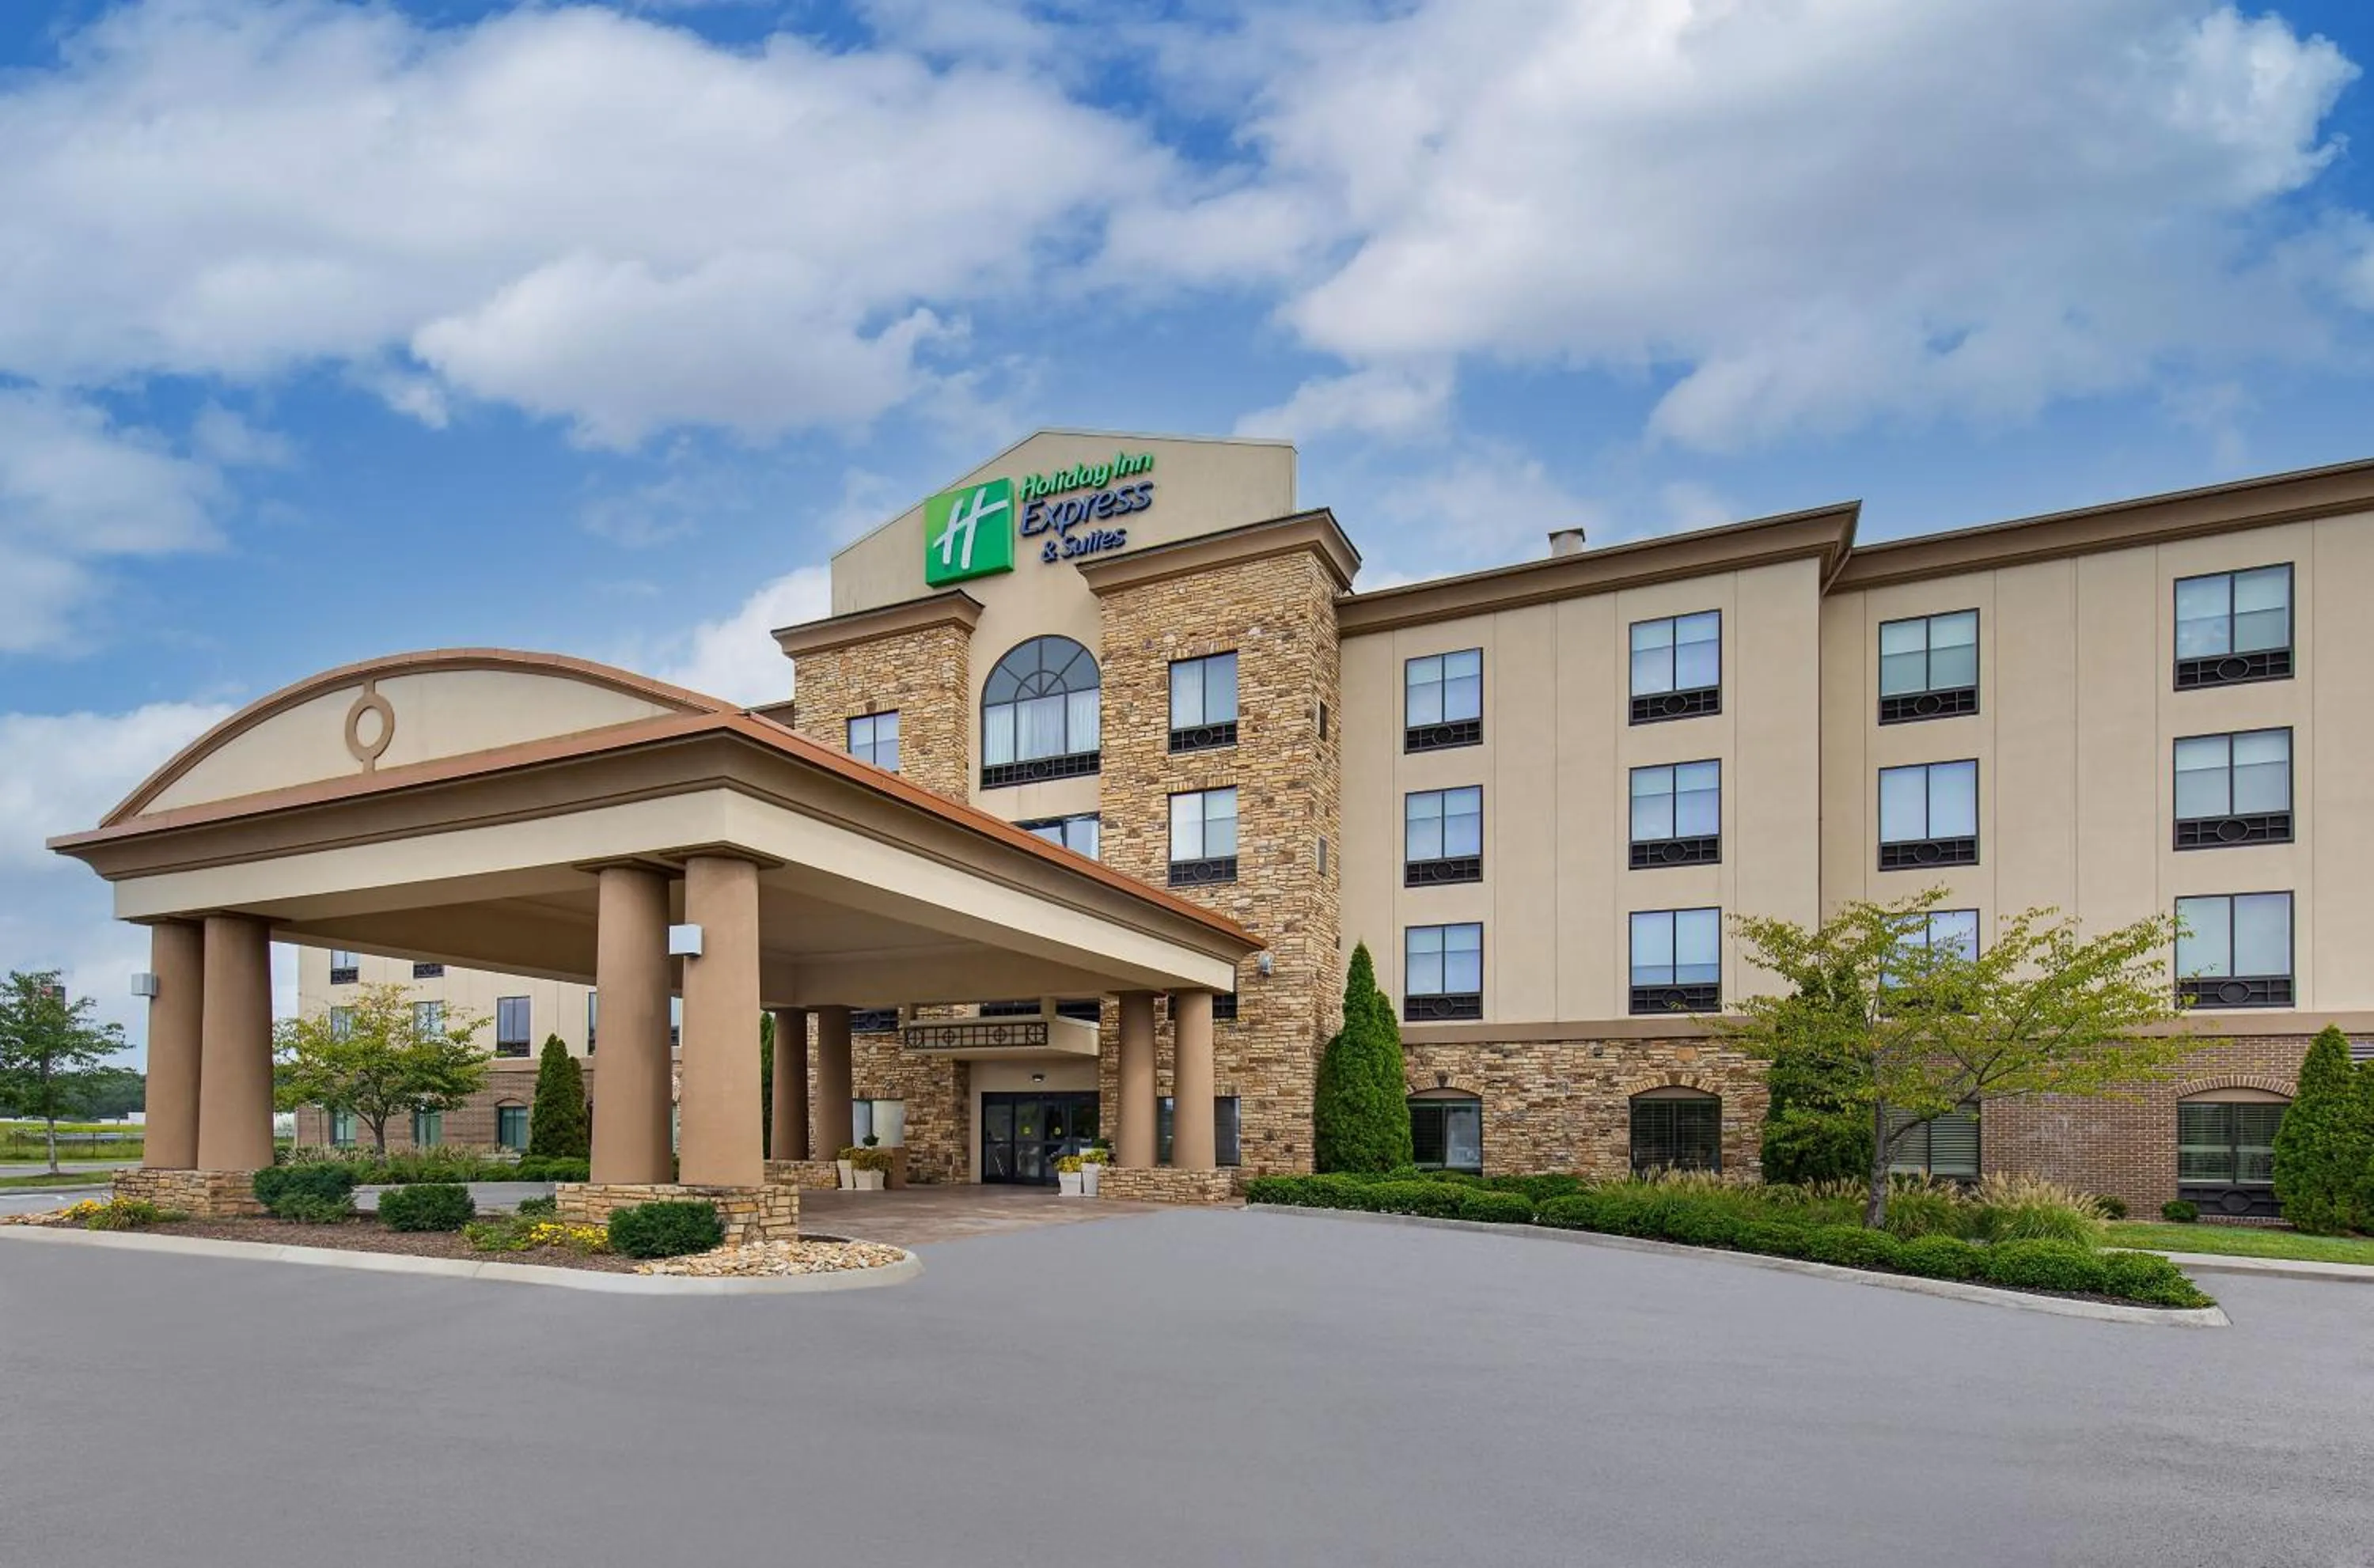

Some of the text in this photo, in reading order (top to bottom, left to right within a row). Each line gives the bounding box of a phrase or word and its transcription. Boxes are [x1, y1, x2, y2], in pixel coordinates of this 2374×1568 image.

[1020, 452, 1153, 501] Holiday Inn
[1020, 481, 1153, 537] Express
[1041, 528, 1127, 562] & Suites
